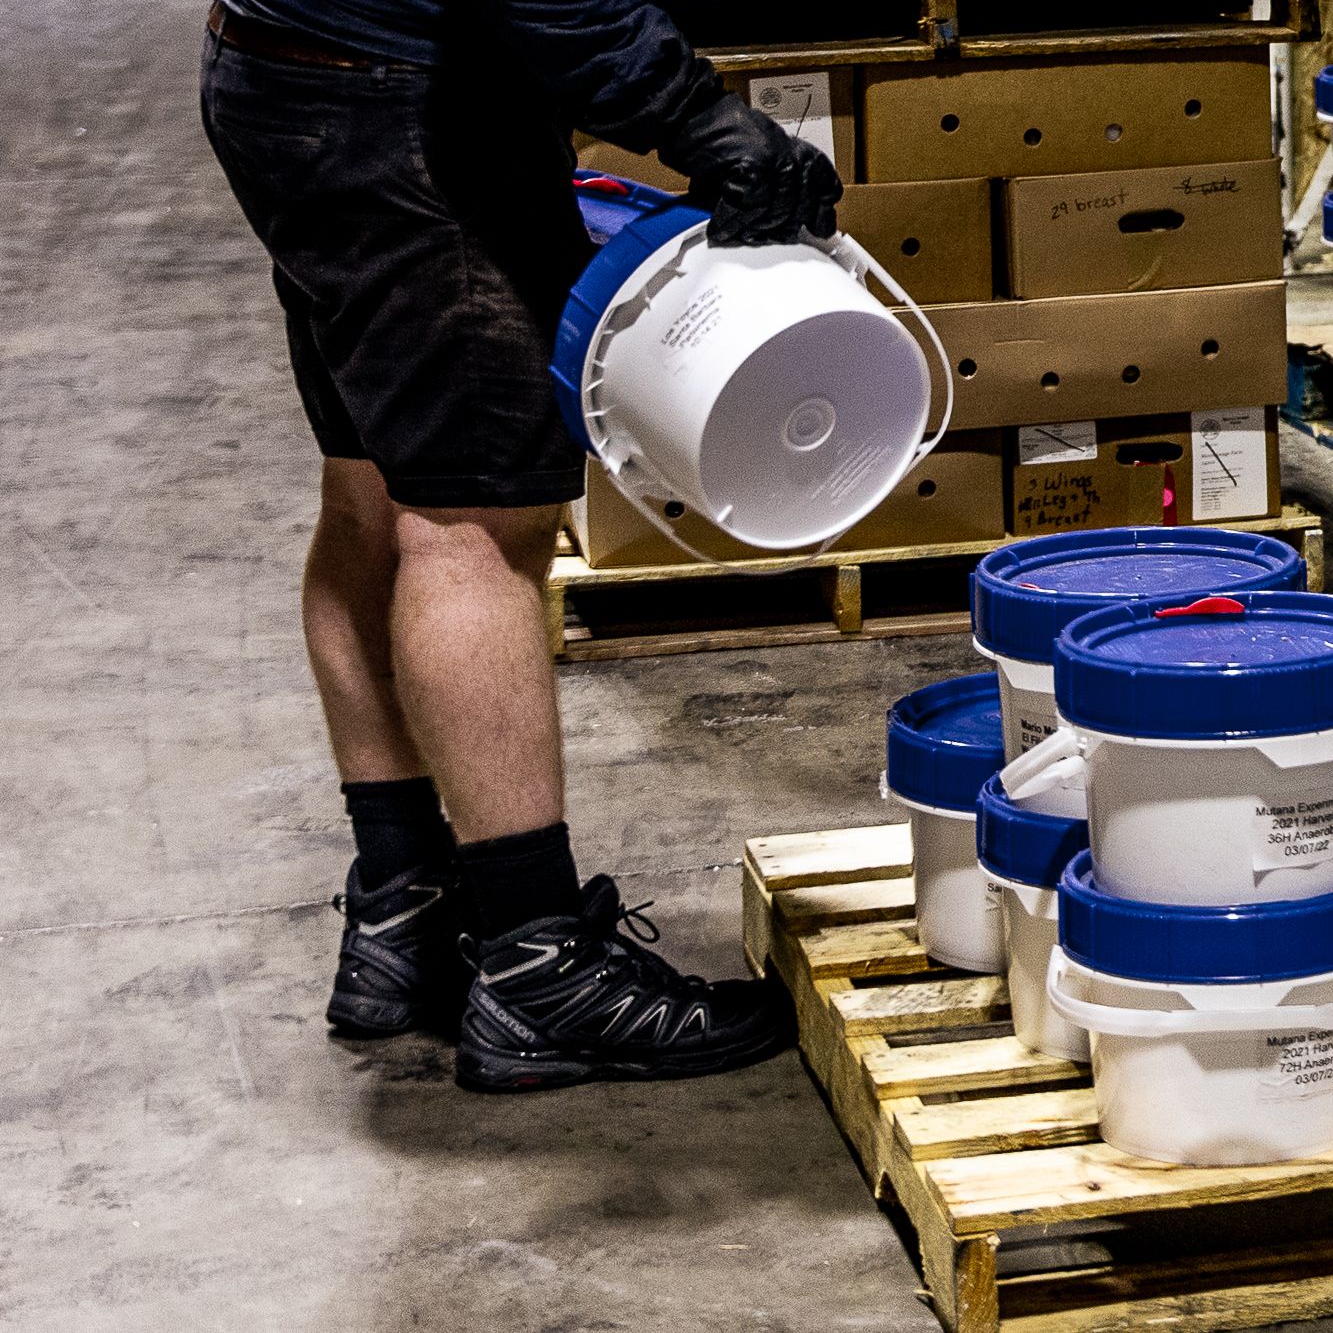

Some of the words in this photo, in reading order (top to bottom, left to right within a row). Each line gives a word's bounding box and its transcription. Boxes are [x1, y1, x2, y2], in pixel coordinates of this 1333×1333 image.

[1074, 188, 1130, 213] breast
[1256, 805, 1295, 816] Mutana
[1271, 818, 1299, 829] 2021
[1267, 833, 1291, 844] 36H
[1284, 840, 1330, 857] 03/07/22
[1266, 1034, 1306, 1046] Mutana
[1281, 1047, 1309, 1059] 2021
[1280, 1062, 1302, 1073] 72H
